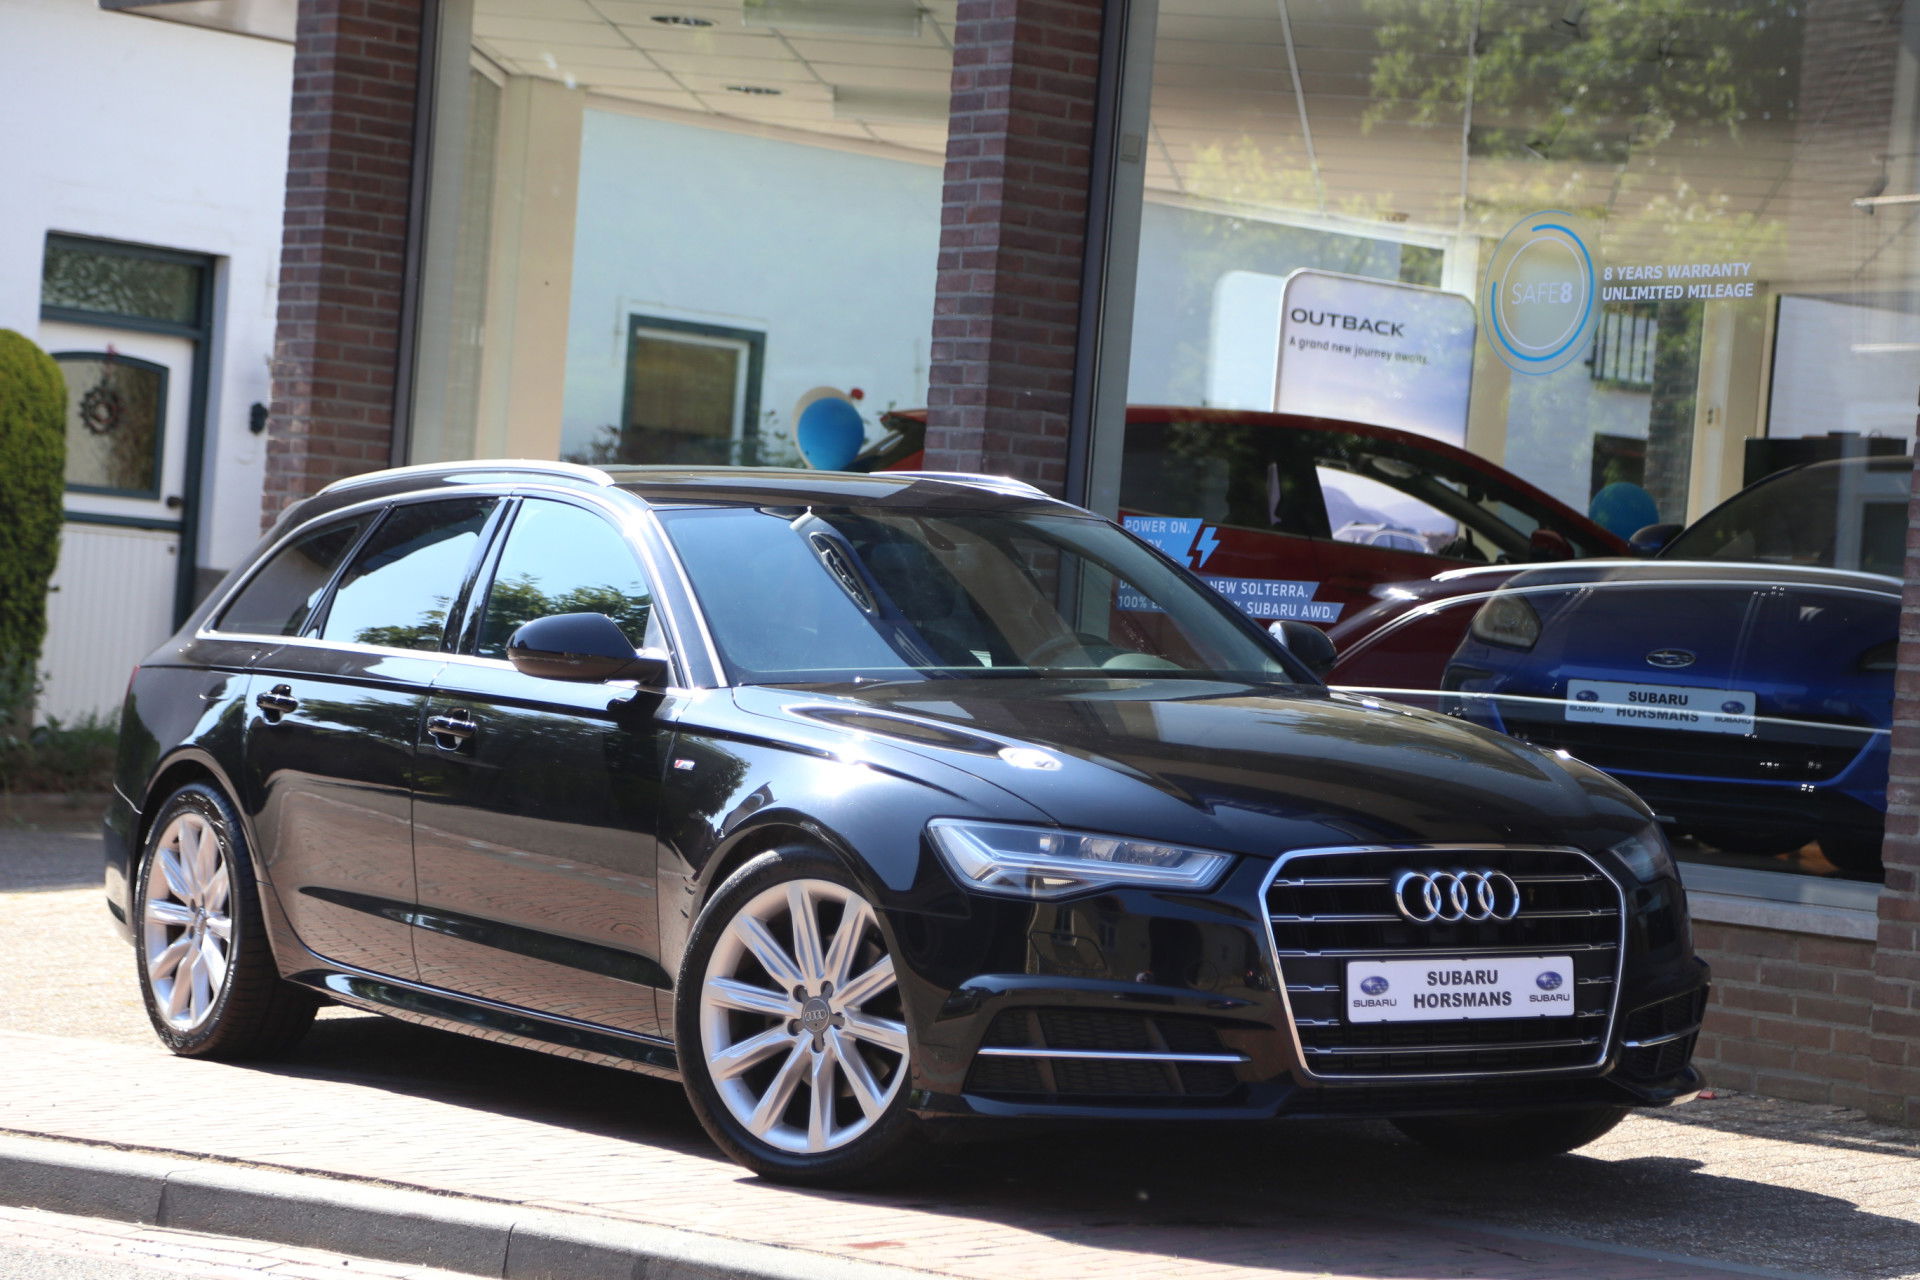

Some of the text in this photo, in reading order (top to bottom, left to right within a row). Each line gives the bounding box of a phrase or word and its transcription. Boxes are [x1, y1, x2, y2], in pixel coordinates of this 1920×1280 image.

[1603, 262, 1752, 281] 8 YEARS WARRANTY
[1511, 281, 1573, 305] SAFE8
[1602, 282, 1754, 301] UNLIMITED MILEAGE
[1290, 307, 1405, 337] OUTBACK
[1289, 335, 1296, 346] A
[1298, 338, 1330, 351] grand
[1331, 342, 1352, 353] new
[1125, 520, 1190, 534] POWER ON.
[1240, 581, 1309, 598] SOLTERRA.
[1246, 601, 1297, 616] SUBARU
[1300, 604, 1335, 619] AWD.
[1628, 691, 1689, 706] SUBARU
[1616, 705, 1700, 723] HORSMANS
[1427, 969, 1499, 987] SUBARU
[1353, 998, 1397, 1008] SUBARU
[1413, 991, 1512, 1009] HORSMANS
[1529, 993, 1570, 1003] SUBARU
